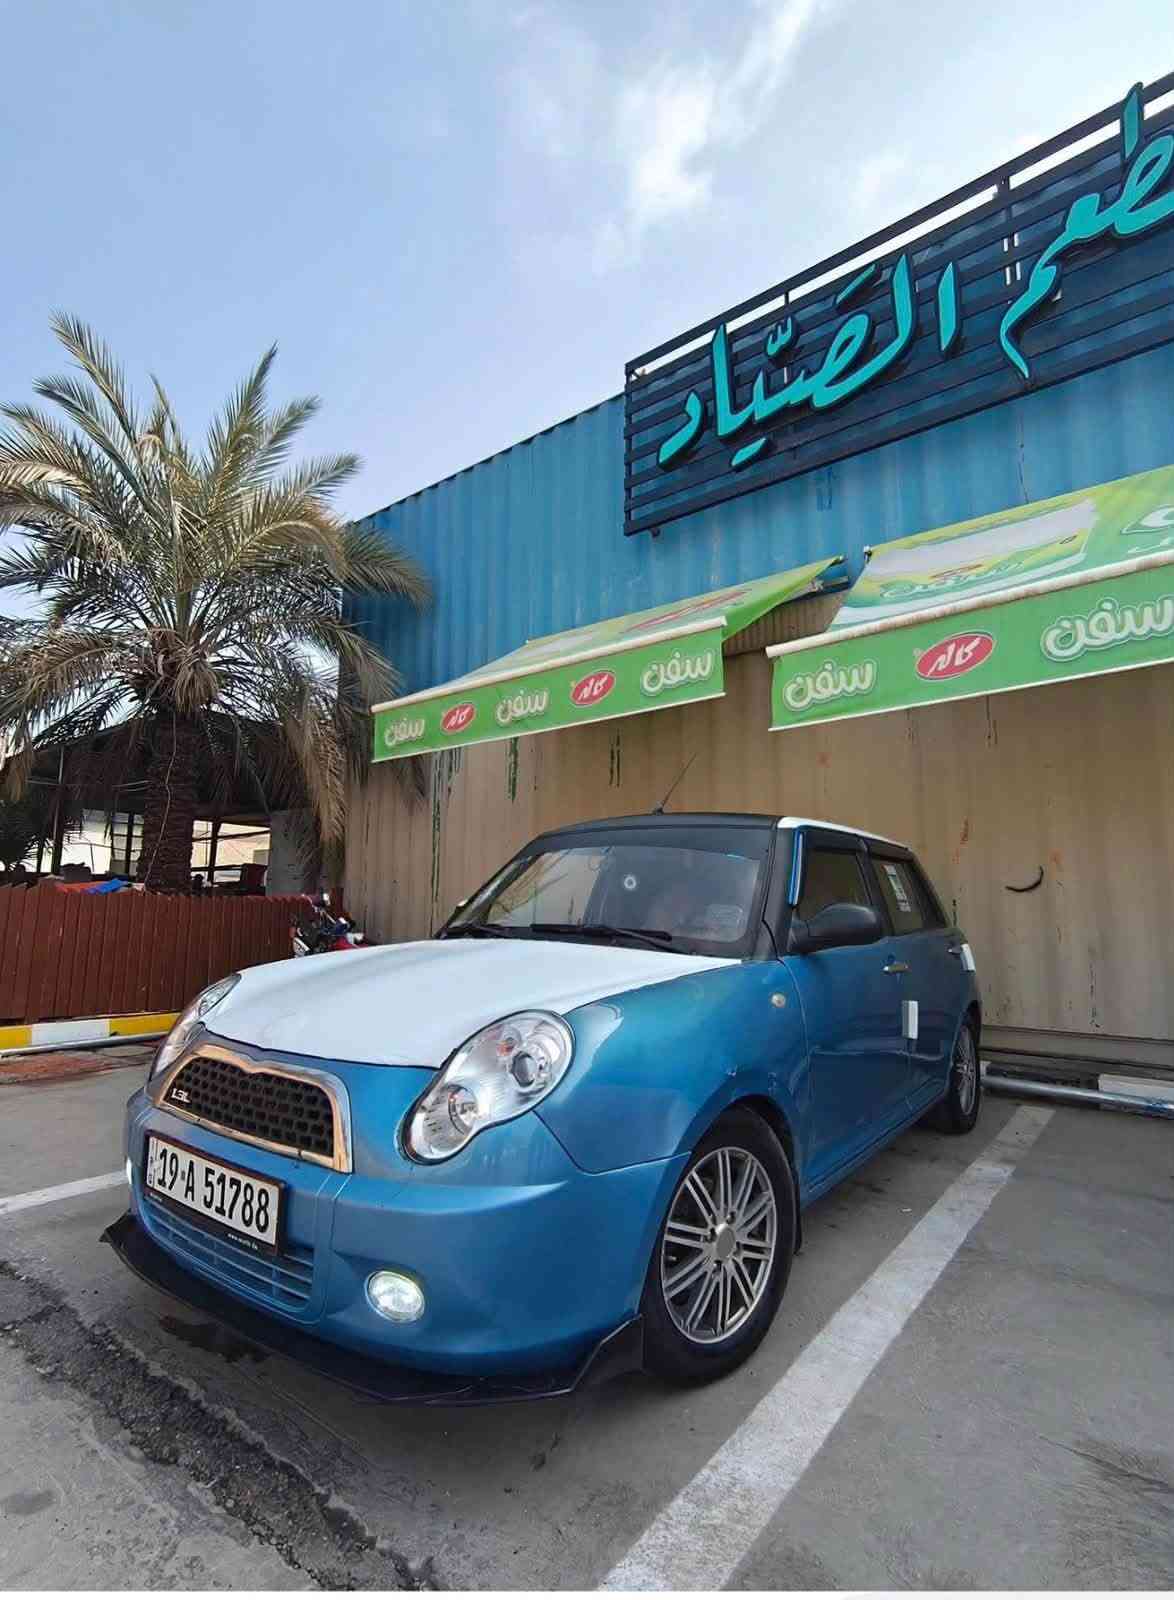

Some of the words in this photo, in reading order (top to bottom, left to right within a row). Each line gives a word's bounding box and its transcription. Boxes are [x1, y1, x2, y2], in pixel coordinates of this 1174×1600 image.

[1000, 82, 1174, 379] طعم
[642, 650, 713, 694] سفن
[784, 660, 877, 710] سفن
[497, 688, 548, 724] سفن
[384, 717, 426, 746] سفن
[203, 1167, 270, 1234] 51788
